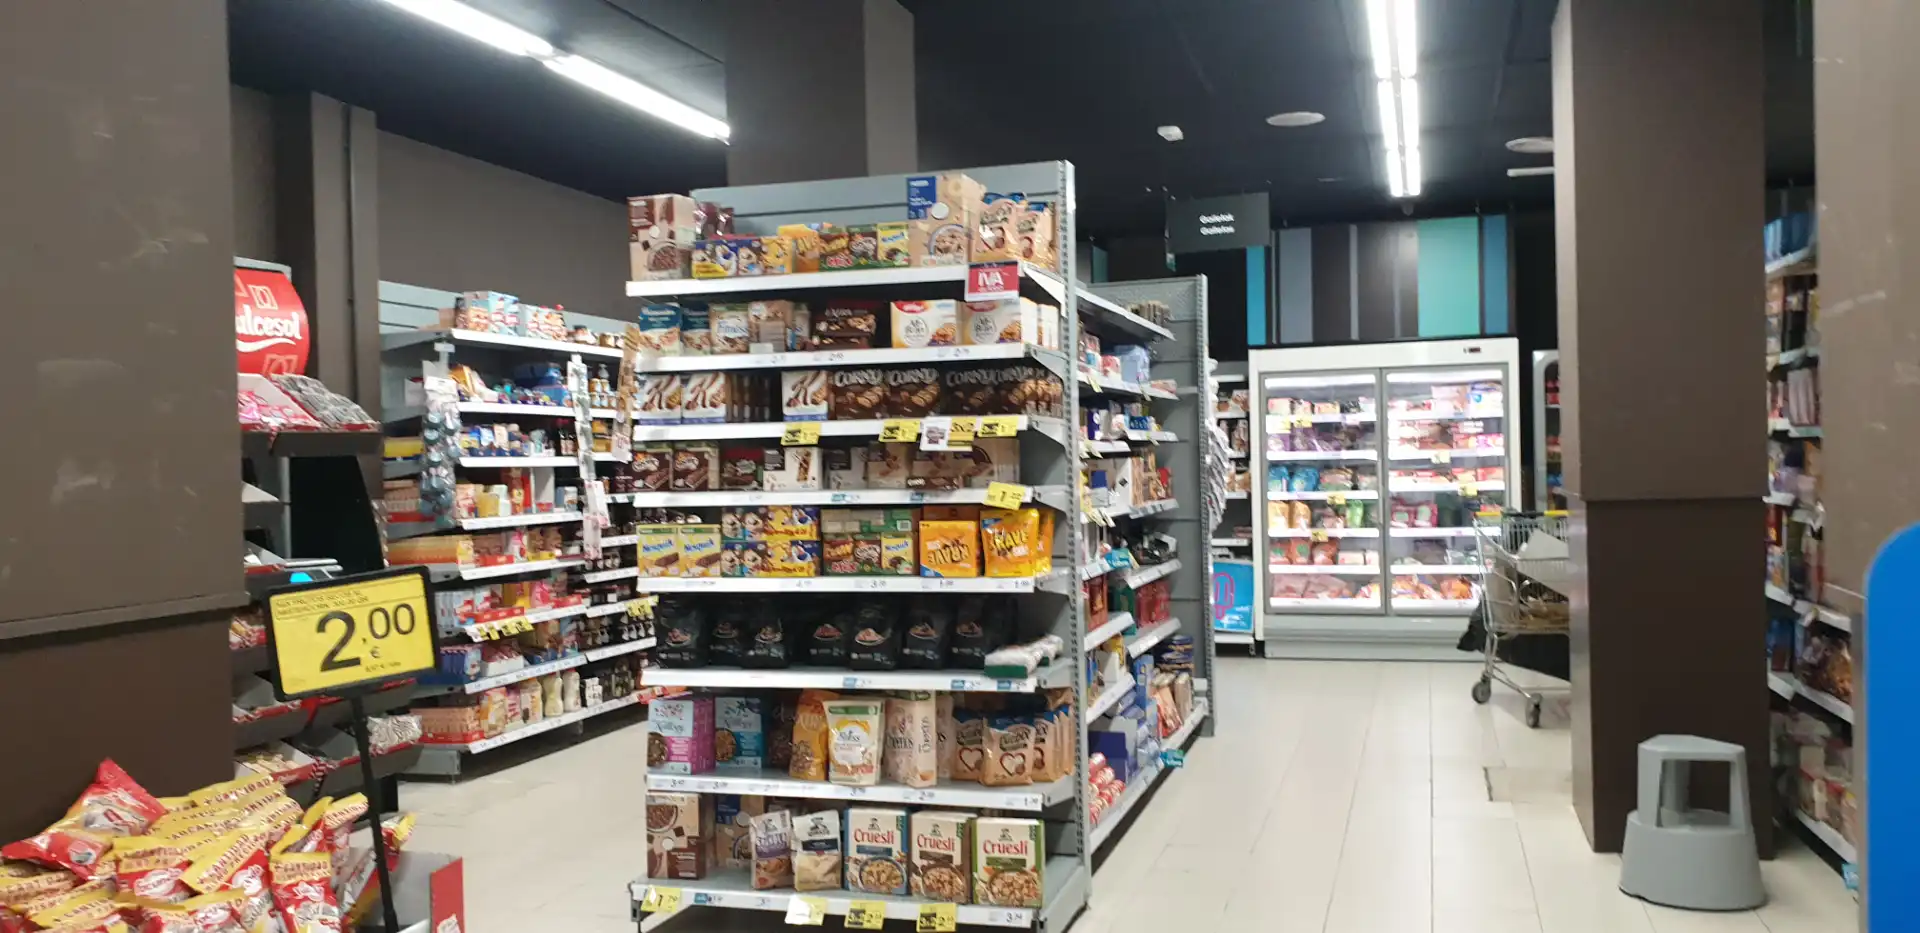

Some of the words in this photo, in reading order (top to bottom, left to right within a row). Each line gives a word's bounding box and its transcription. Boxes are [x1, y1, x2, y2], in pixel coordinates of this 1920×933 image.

[977, 270, 1004, 288] IVA
[834, 368, 883, 387] CORNY
[887, 368, 940, 386] CORNY
[642, 538, 674, 553] Nesquik
[684, 537, 714, 553] Nesquik
[853, 829, 894, 845] Cruesli
[917, 834, 955, 852] Cruesli
[982, 840, 1028, 856] Cruesli
